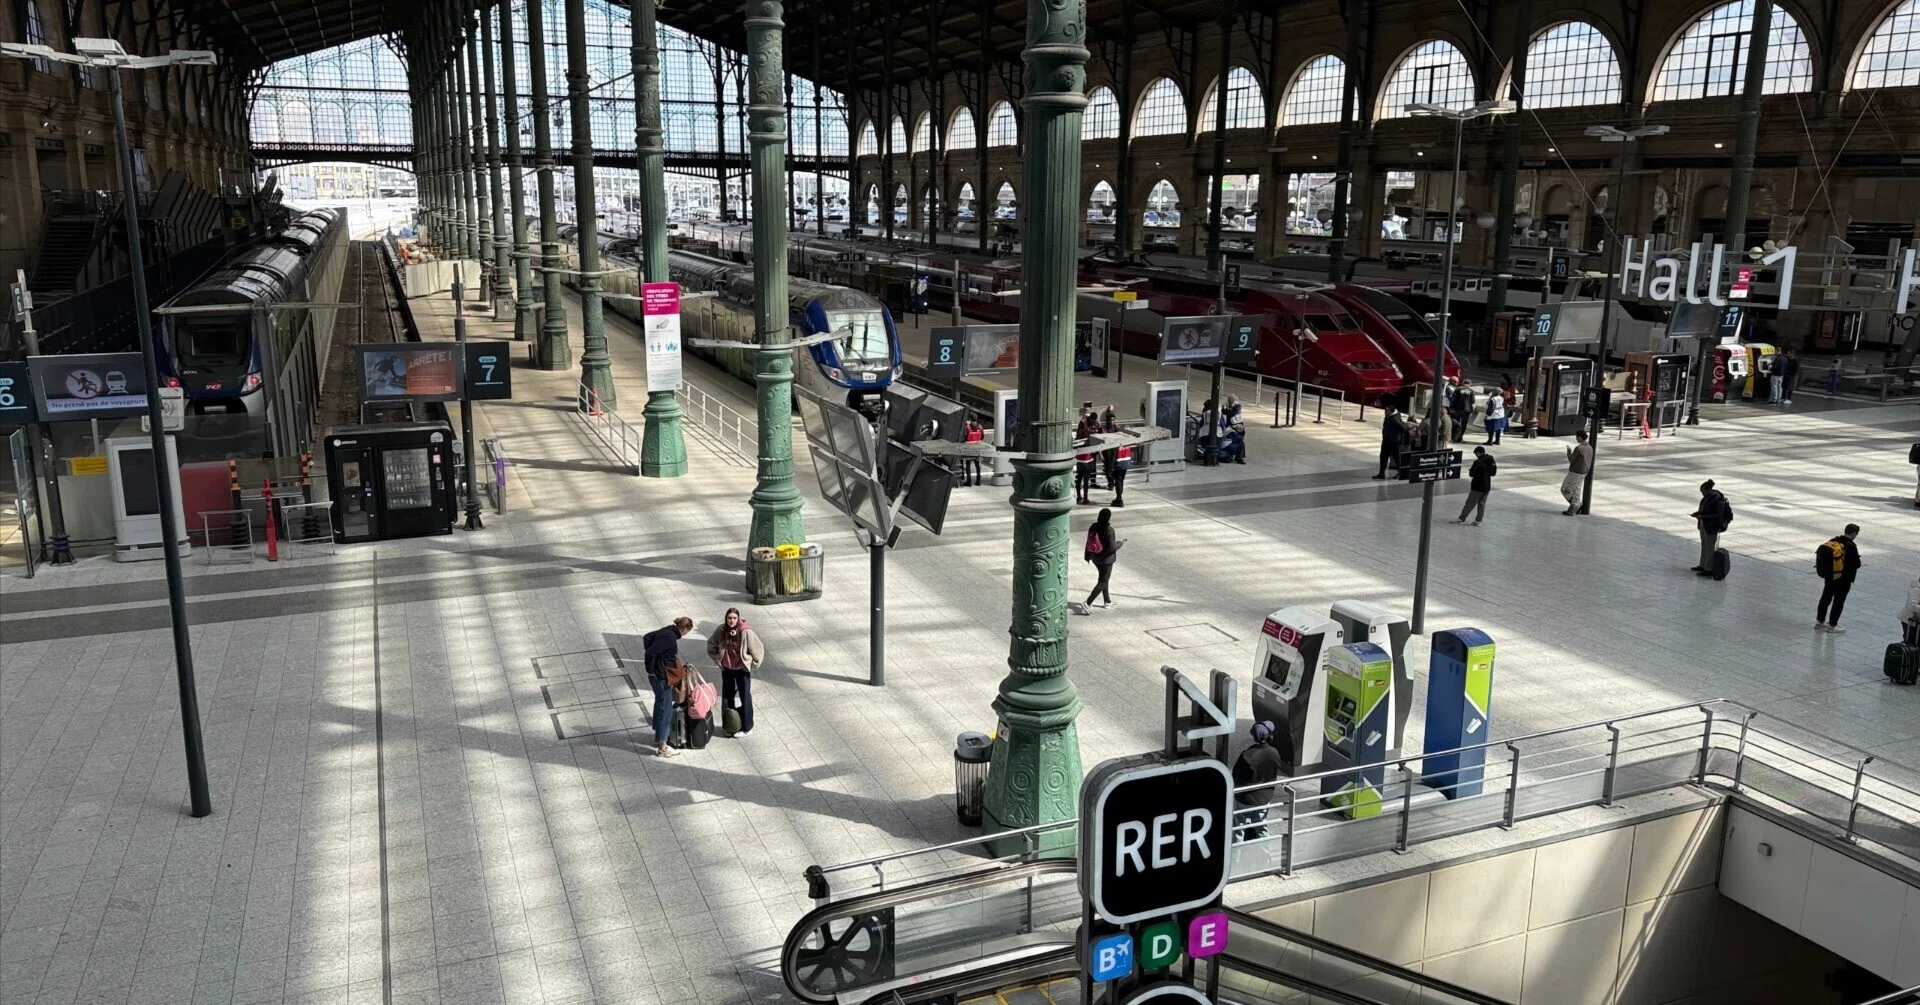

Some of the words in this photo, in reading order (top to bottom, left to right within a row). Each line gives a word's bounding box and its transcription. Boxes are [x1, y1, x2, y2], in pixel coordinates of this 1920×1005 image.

[1555, 263, 1566, 275] 10
[1621, 238, 1728, 306] Hall
[1762, 246, 1797, 310] 1
[1229, 273, 1235, 285] 9
[1536, 320, 1551, 333] 10
[1725, 312, 1738, 325] 11
[1238, 333, 1249, 348] 9
[940, 346, 951, 362] 8
[481, 364, 496, 382] 7
[0, 386, 15, 406] 6
[64, 400, 85, 409] prend
[87, 401, 99, 409] pas
[110, 398, 146, 407] voyageurs
[1115, 807, 1213, 877] RER
[1200, 923, 1216, 948] E
[1152, 934, 1172, 960] D
[1099, 947, 1116, 973] B
